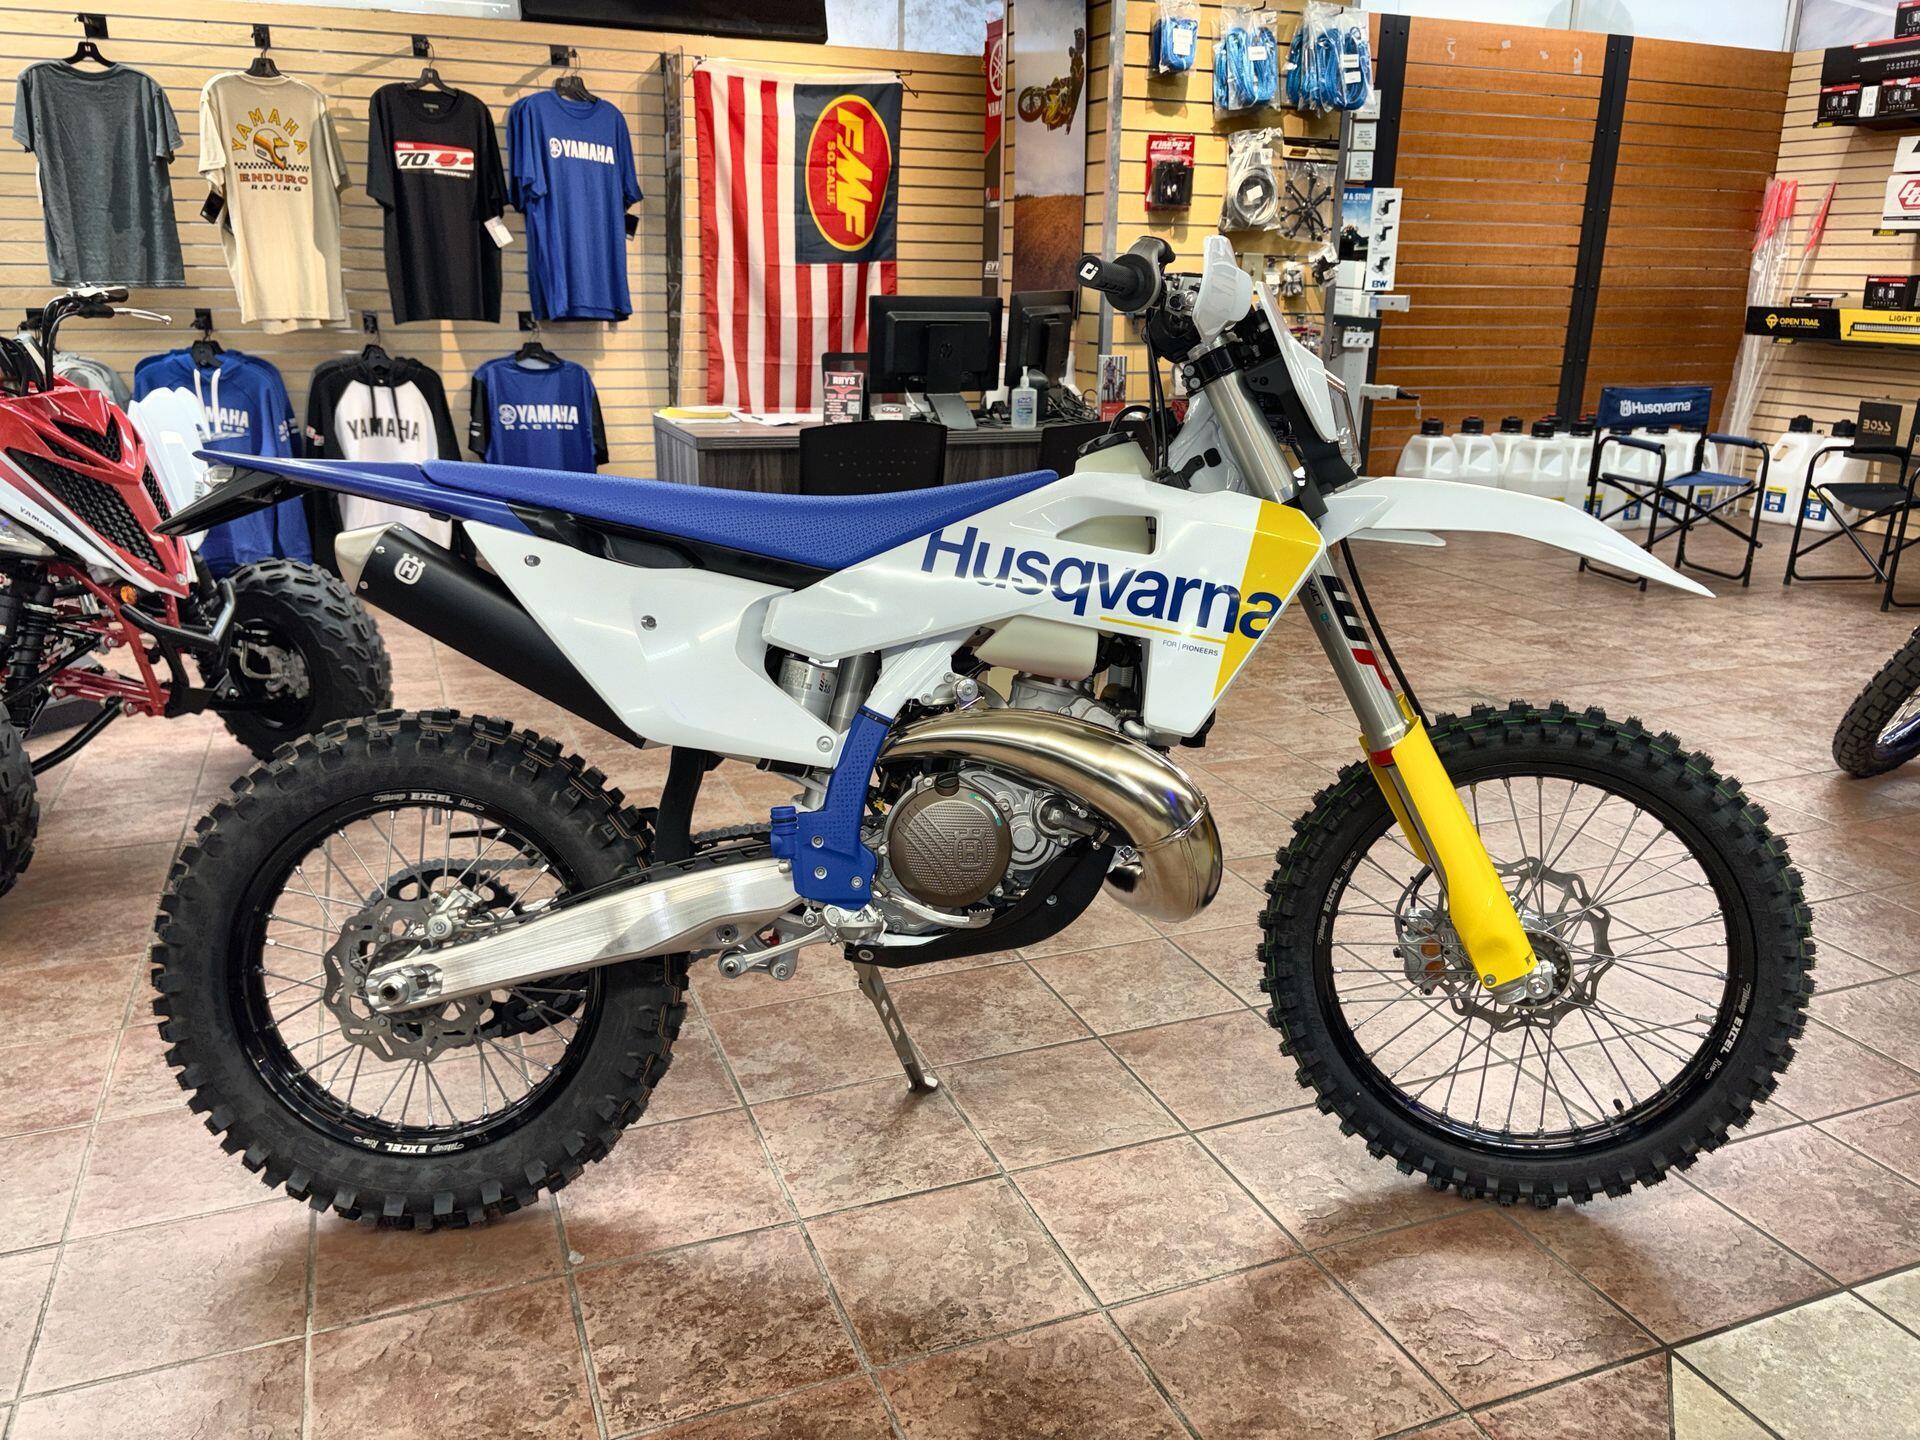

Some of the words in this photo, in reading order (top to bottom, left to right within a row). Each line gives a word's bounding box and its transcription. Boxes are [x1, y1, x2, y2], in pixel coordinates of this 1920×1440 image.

[231, 107, 308, 155] YAMAHA
[561, 138, 615, 165] YAMAHA
[1150, 139, 1193, 151] KIMPEX
[399, 152, 430, 167] 70
[239, 172, 309, 185] ENDURO
[836, 106, 873, 239] FMF
[251, 184, 302, 192] RACING
[1779, 317, 1799, 326] OPEN
[1800, 318, 1820, 327] TRAIL
[1888, 314, 1913, 322] LIGHT
[515, 404, 579, 425] YAMAHA
[1631, 400, 1692, 415] Husqvarna
[346, 417, 420, 441] YAMAHA
[1862, 418, 1892, 432] BOSS
[921, 526, 1282, 640] Husqvarna
[1162, 639, 1177, 648] FOR
[1181, 643, 1219, 657] PIONEERS
[410, 792, 454, 804] EXCEL
[1323, 876, 1343, 913] EXCEL
[1720, 1016, 1744, 1054] EXCEL
[384, 1142, 429, 1154] EXCEL
